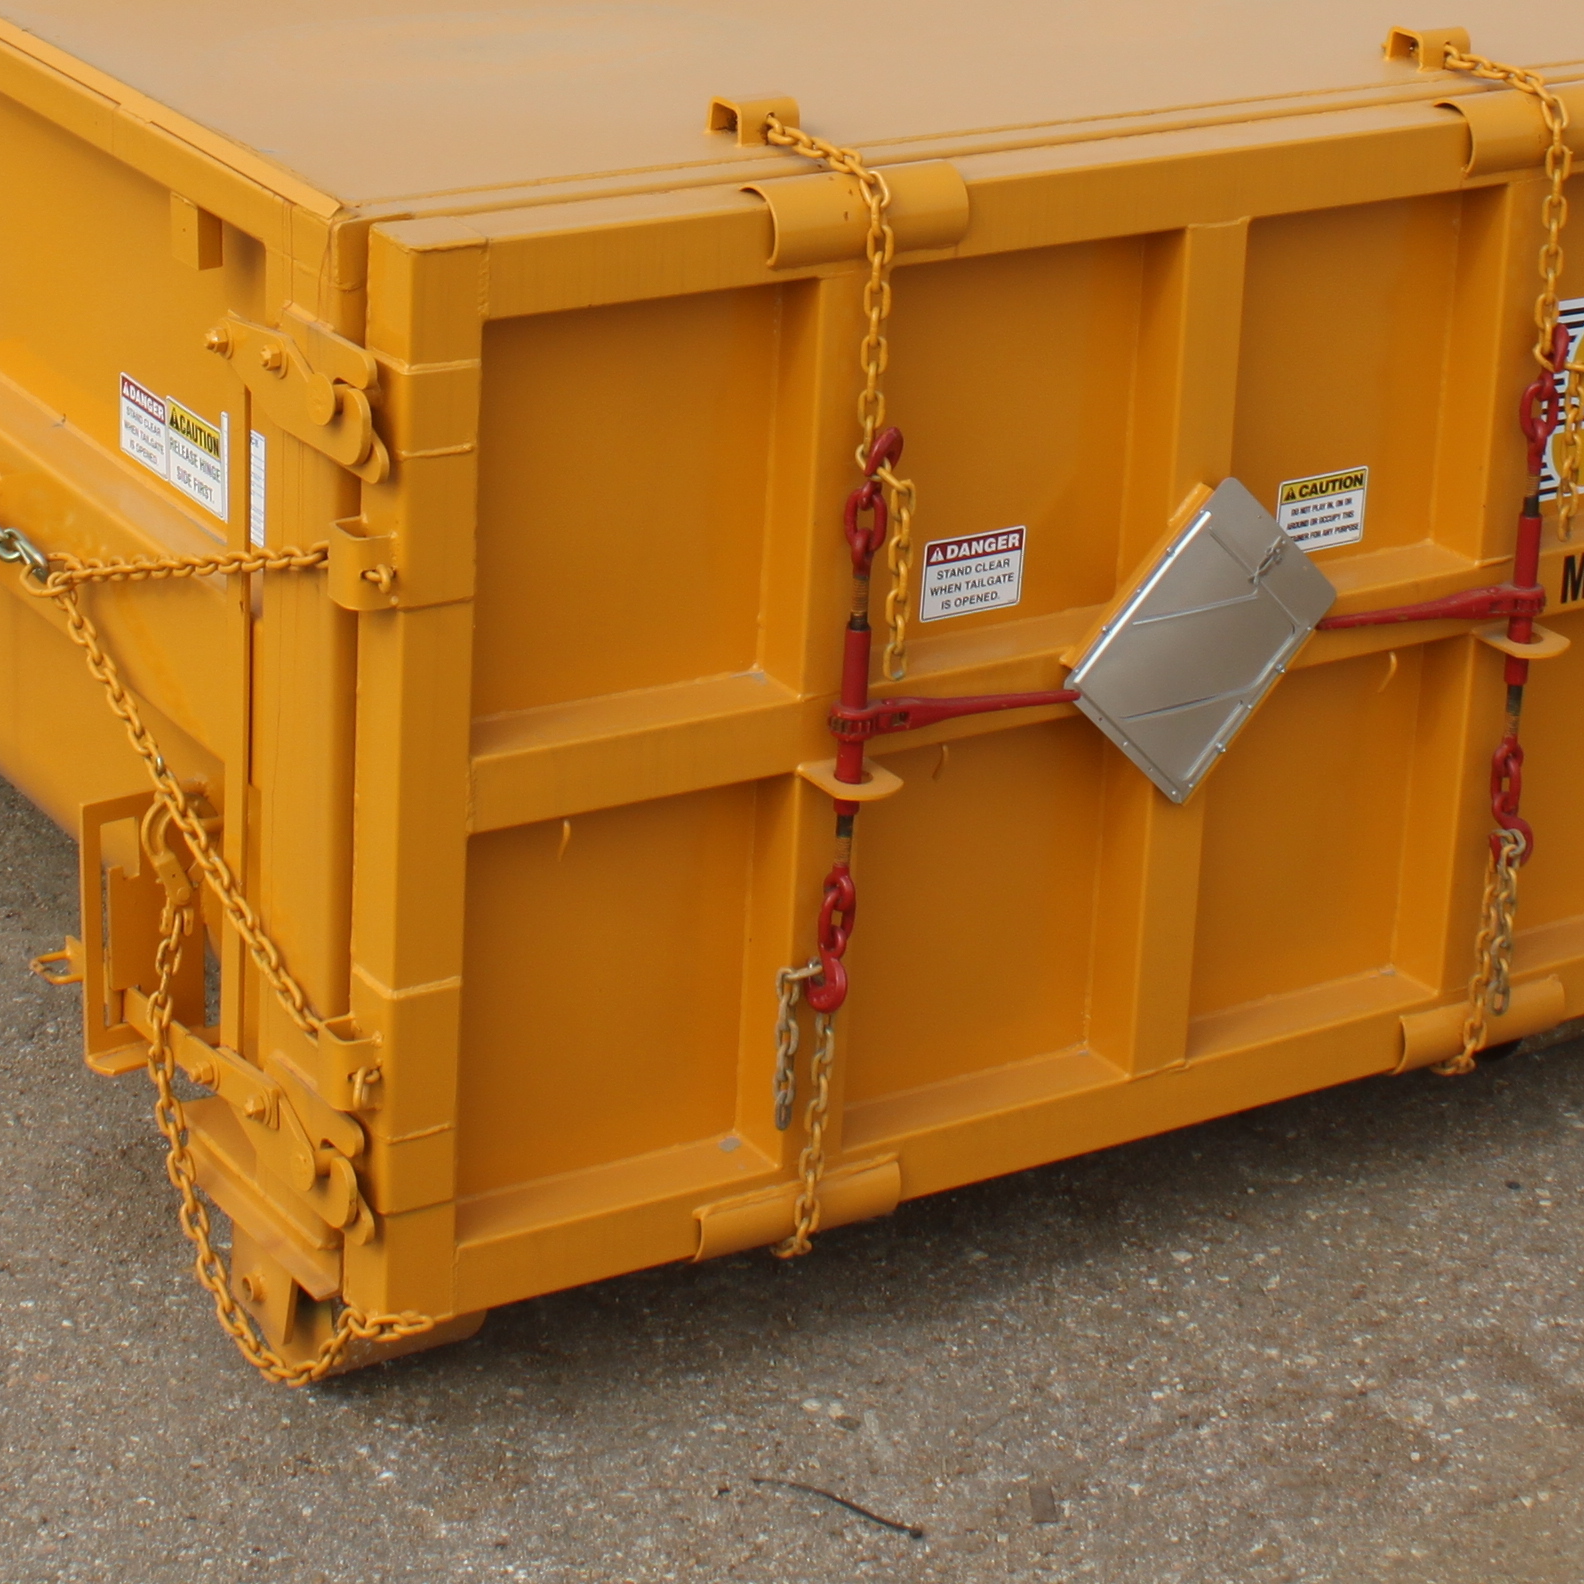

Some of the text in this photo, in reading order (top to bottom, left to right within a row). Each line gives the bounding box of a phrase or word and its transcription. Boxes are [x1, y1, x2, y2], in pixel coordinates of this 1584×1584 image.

[129, 385, 165, 420] DANGER
[179, 415, 220, 459] CAUTION
[170, 435, 221, 484] RELEASE HINGE
[176, 464, 193, 489] SIDE
[1299, 473, 1364, 498] CAUTION
[945, 533, 1020, 560] DANGER
[936, 558, 1011, 581] STAND CLEAR
[929, 572, 1015, 597] WHEN TAILGATE
[941, 599, 951, 611] IS
